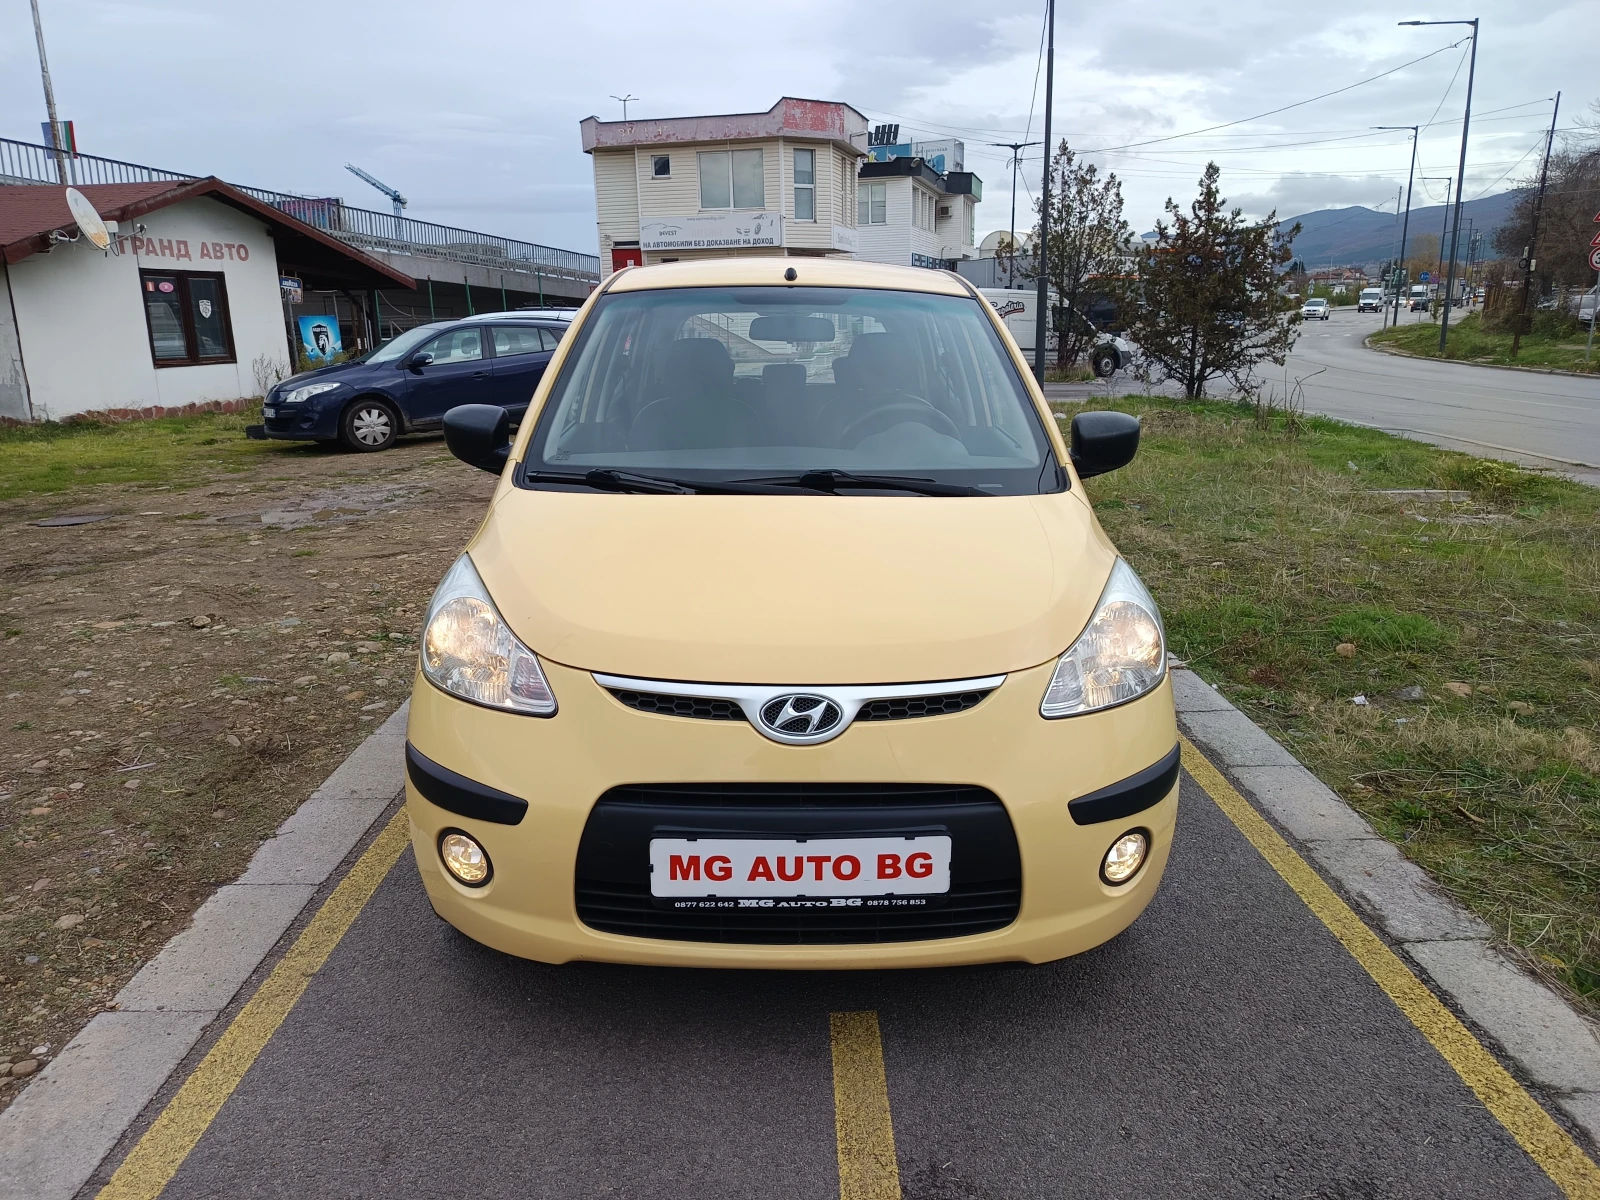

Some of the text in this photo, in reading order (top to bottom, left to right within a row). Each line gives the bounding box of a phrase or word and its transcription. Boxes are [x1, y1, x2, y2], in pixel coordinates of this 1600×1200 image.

[116, 235, 249, 262] ГРАНД АВТО
[643, 241, 651, 249] НА
[652, 240, 693, 249] АВТОМОБИЛИ
[706, 239, 742, 248] ДОКАЗВАНЕ
[743, 238, 752, 246] НА
[752, 237, 774, 246] ДОХОД
[669, 852, 933, 882] MG AUTO BG
[738, 899, 775, 908] MG
[829, 898, 863, 907] BG
